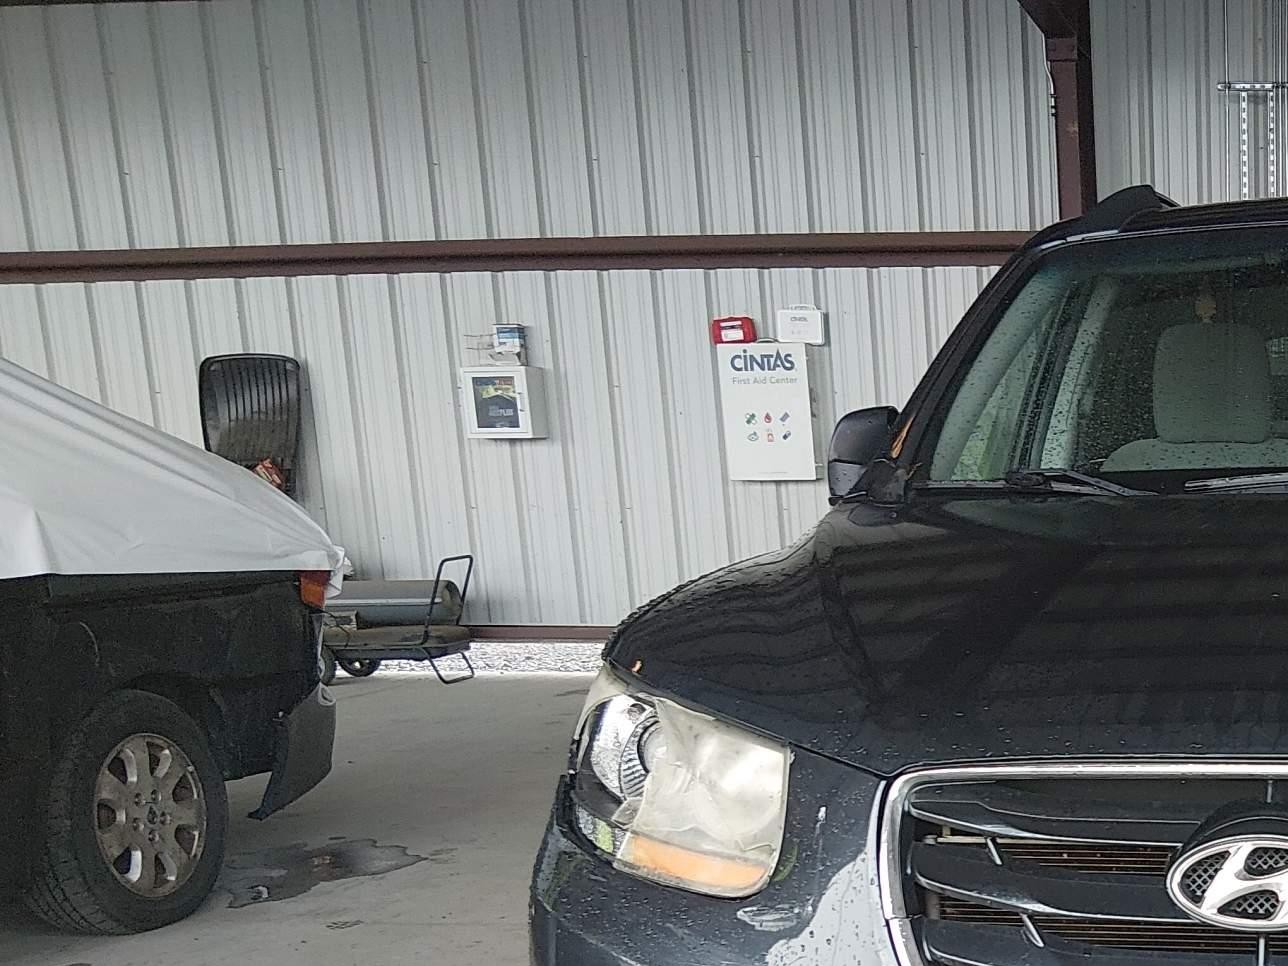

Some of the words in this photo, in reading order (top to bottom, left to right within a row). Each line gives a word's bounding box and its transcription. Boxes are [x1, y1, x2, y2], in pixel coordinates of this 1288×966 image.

[732, 377, 751, 385] First
[753, 377, 768, 385] Aid
[769, 377, 798, 385] Center
